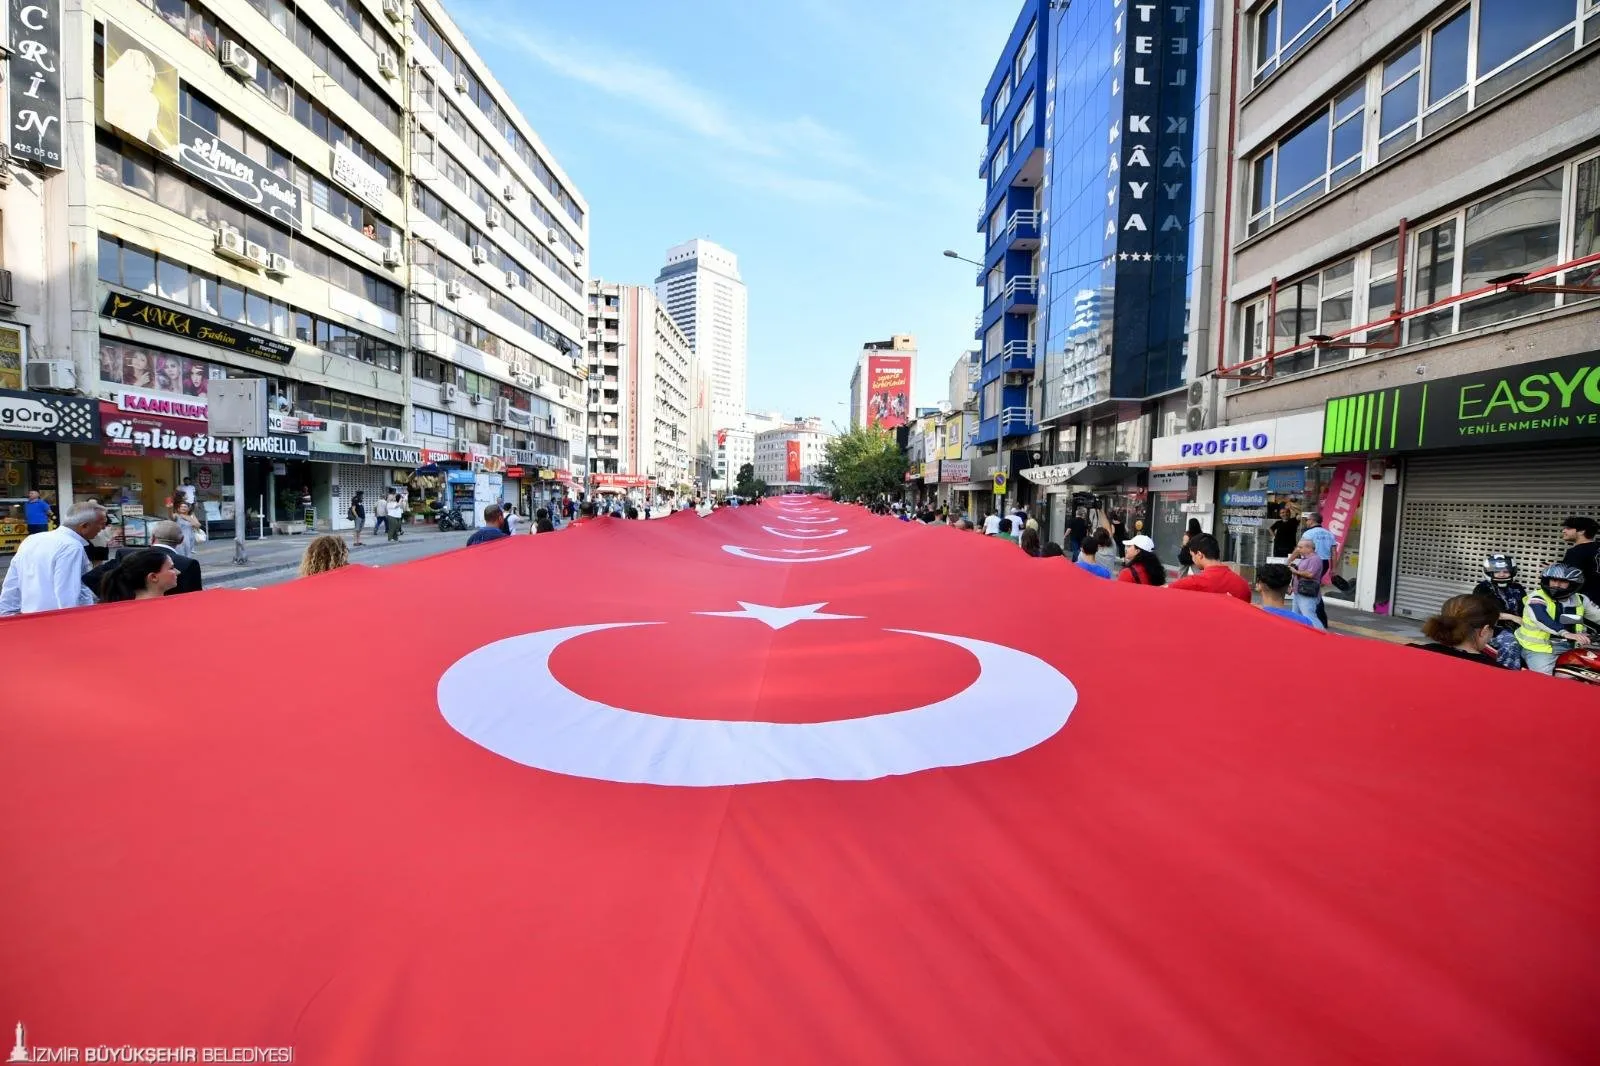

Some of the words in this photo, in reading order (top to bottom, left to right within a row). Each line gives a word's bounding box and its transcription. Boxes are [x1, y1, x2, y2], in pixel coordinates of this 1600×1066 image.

[14, 142, 32, 153] 425
[47, 151, 59, 161] 03
[1123, 115, 1151, 231] KÂYA
[132, 305, 191, 334] ANKA
[196, 326, 236, 345] Fashion
[2, 408, 53, 424] gora
[124, 394, 170, 414] KAAN
[171, 402, 208, 420] KUAF
[1459, 415, 1569, 436] YENİLENMENİN
[1576, 413, 1600, 425] YE
[246, 436, 297, 453] BARGELLO
